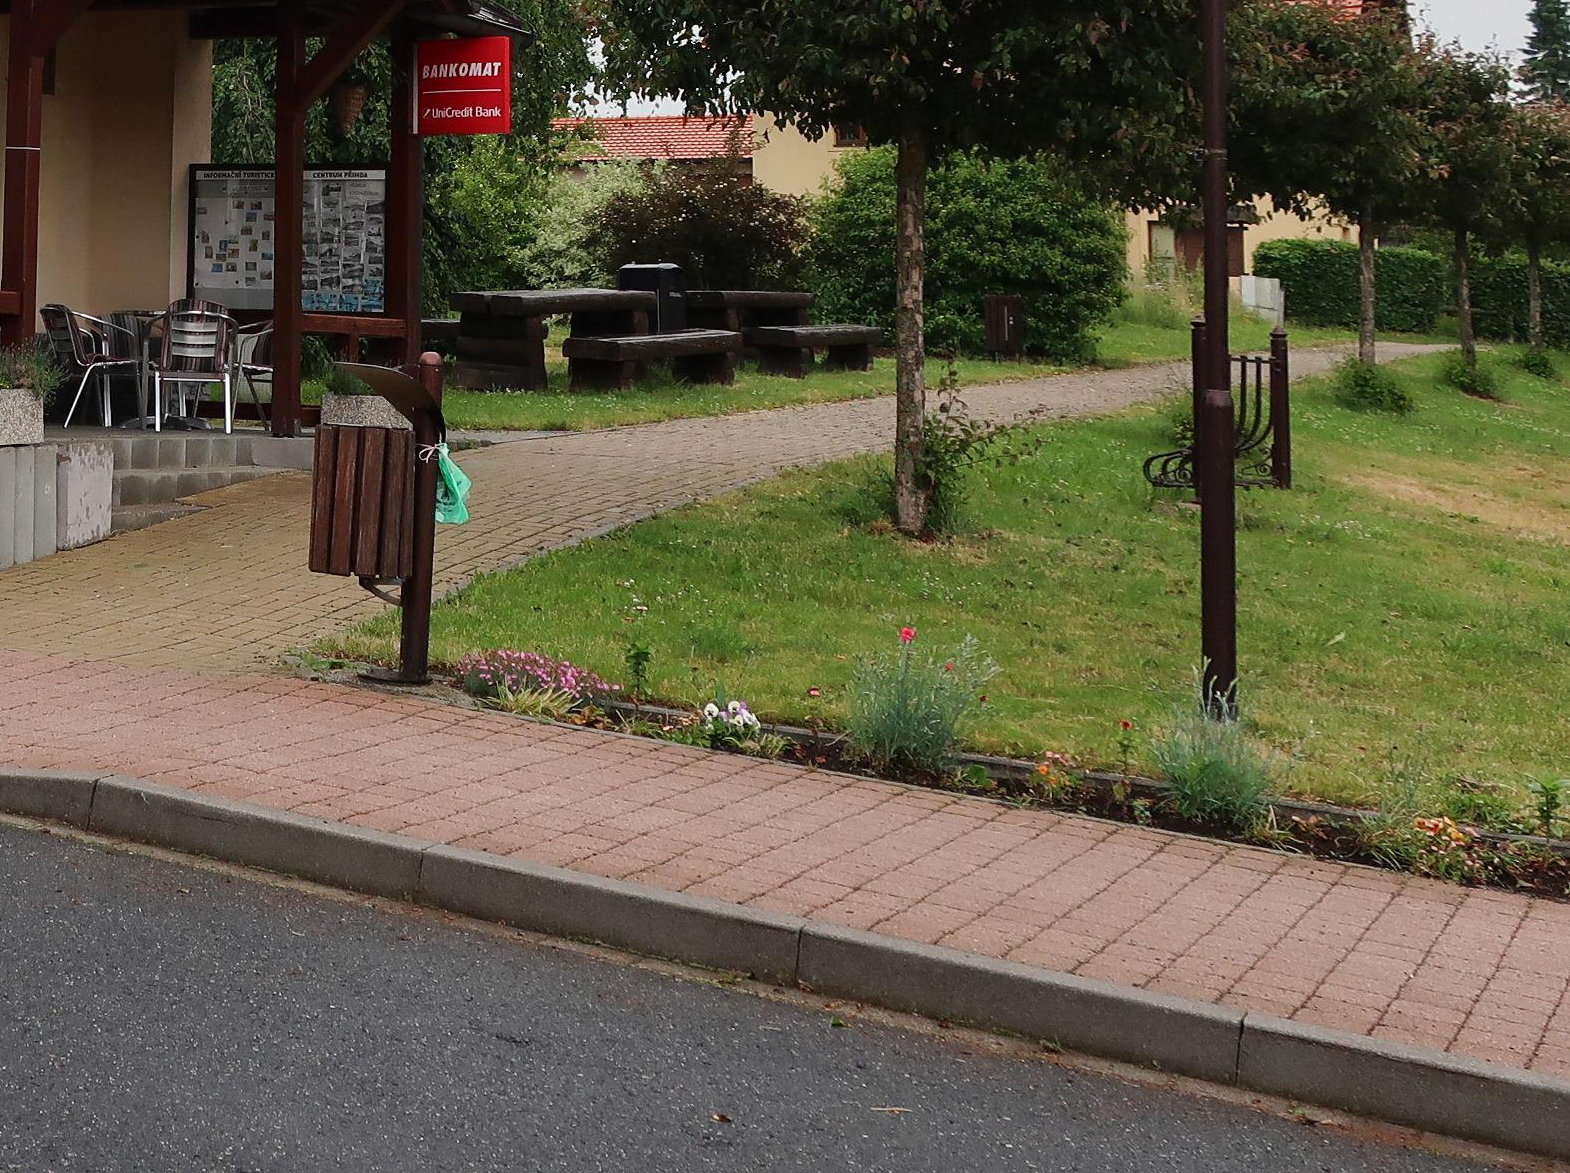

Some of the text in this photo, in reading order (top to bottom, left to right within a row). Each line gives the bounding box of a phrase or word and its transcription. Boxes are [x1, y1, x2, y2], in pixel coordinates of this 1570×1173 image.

[422, 62, 502, 79] BANKOMAT
[432, 106, 502, 118] UniCredit Bank
